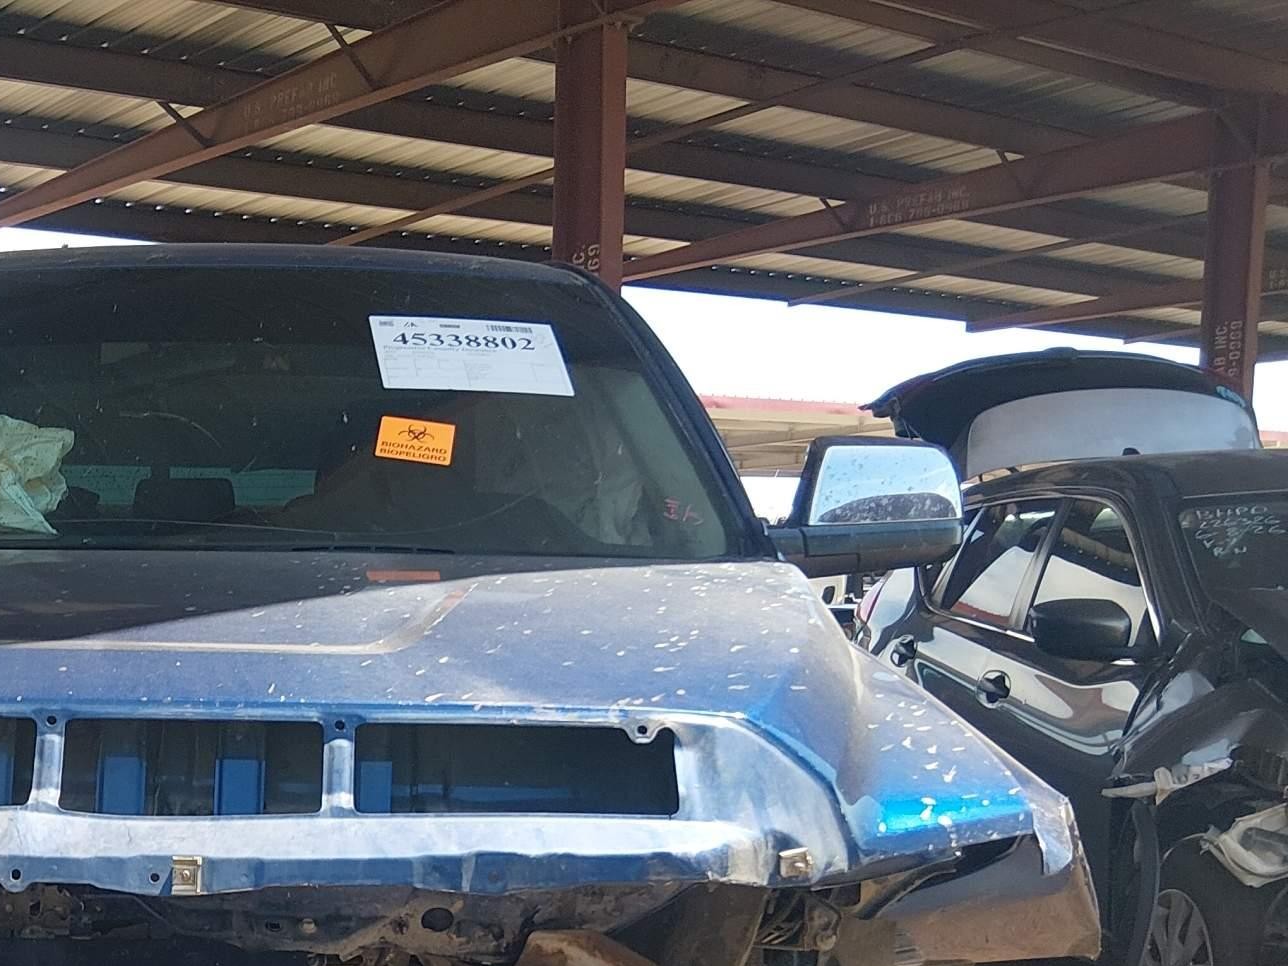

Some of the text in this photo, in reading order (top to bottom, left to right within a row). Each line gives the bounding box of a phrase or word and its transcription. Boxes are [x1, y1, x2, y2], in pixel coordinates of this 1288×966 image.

[393, 332, 536, 351] 45338802
[379, 448, 447, 462] BIOPELIGRO
[381, 440, 448, 455] BIOHAZARD
